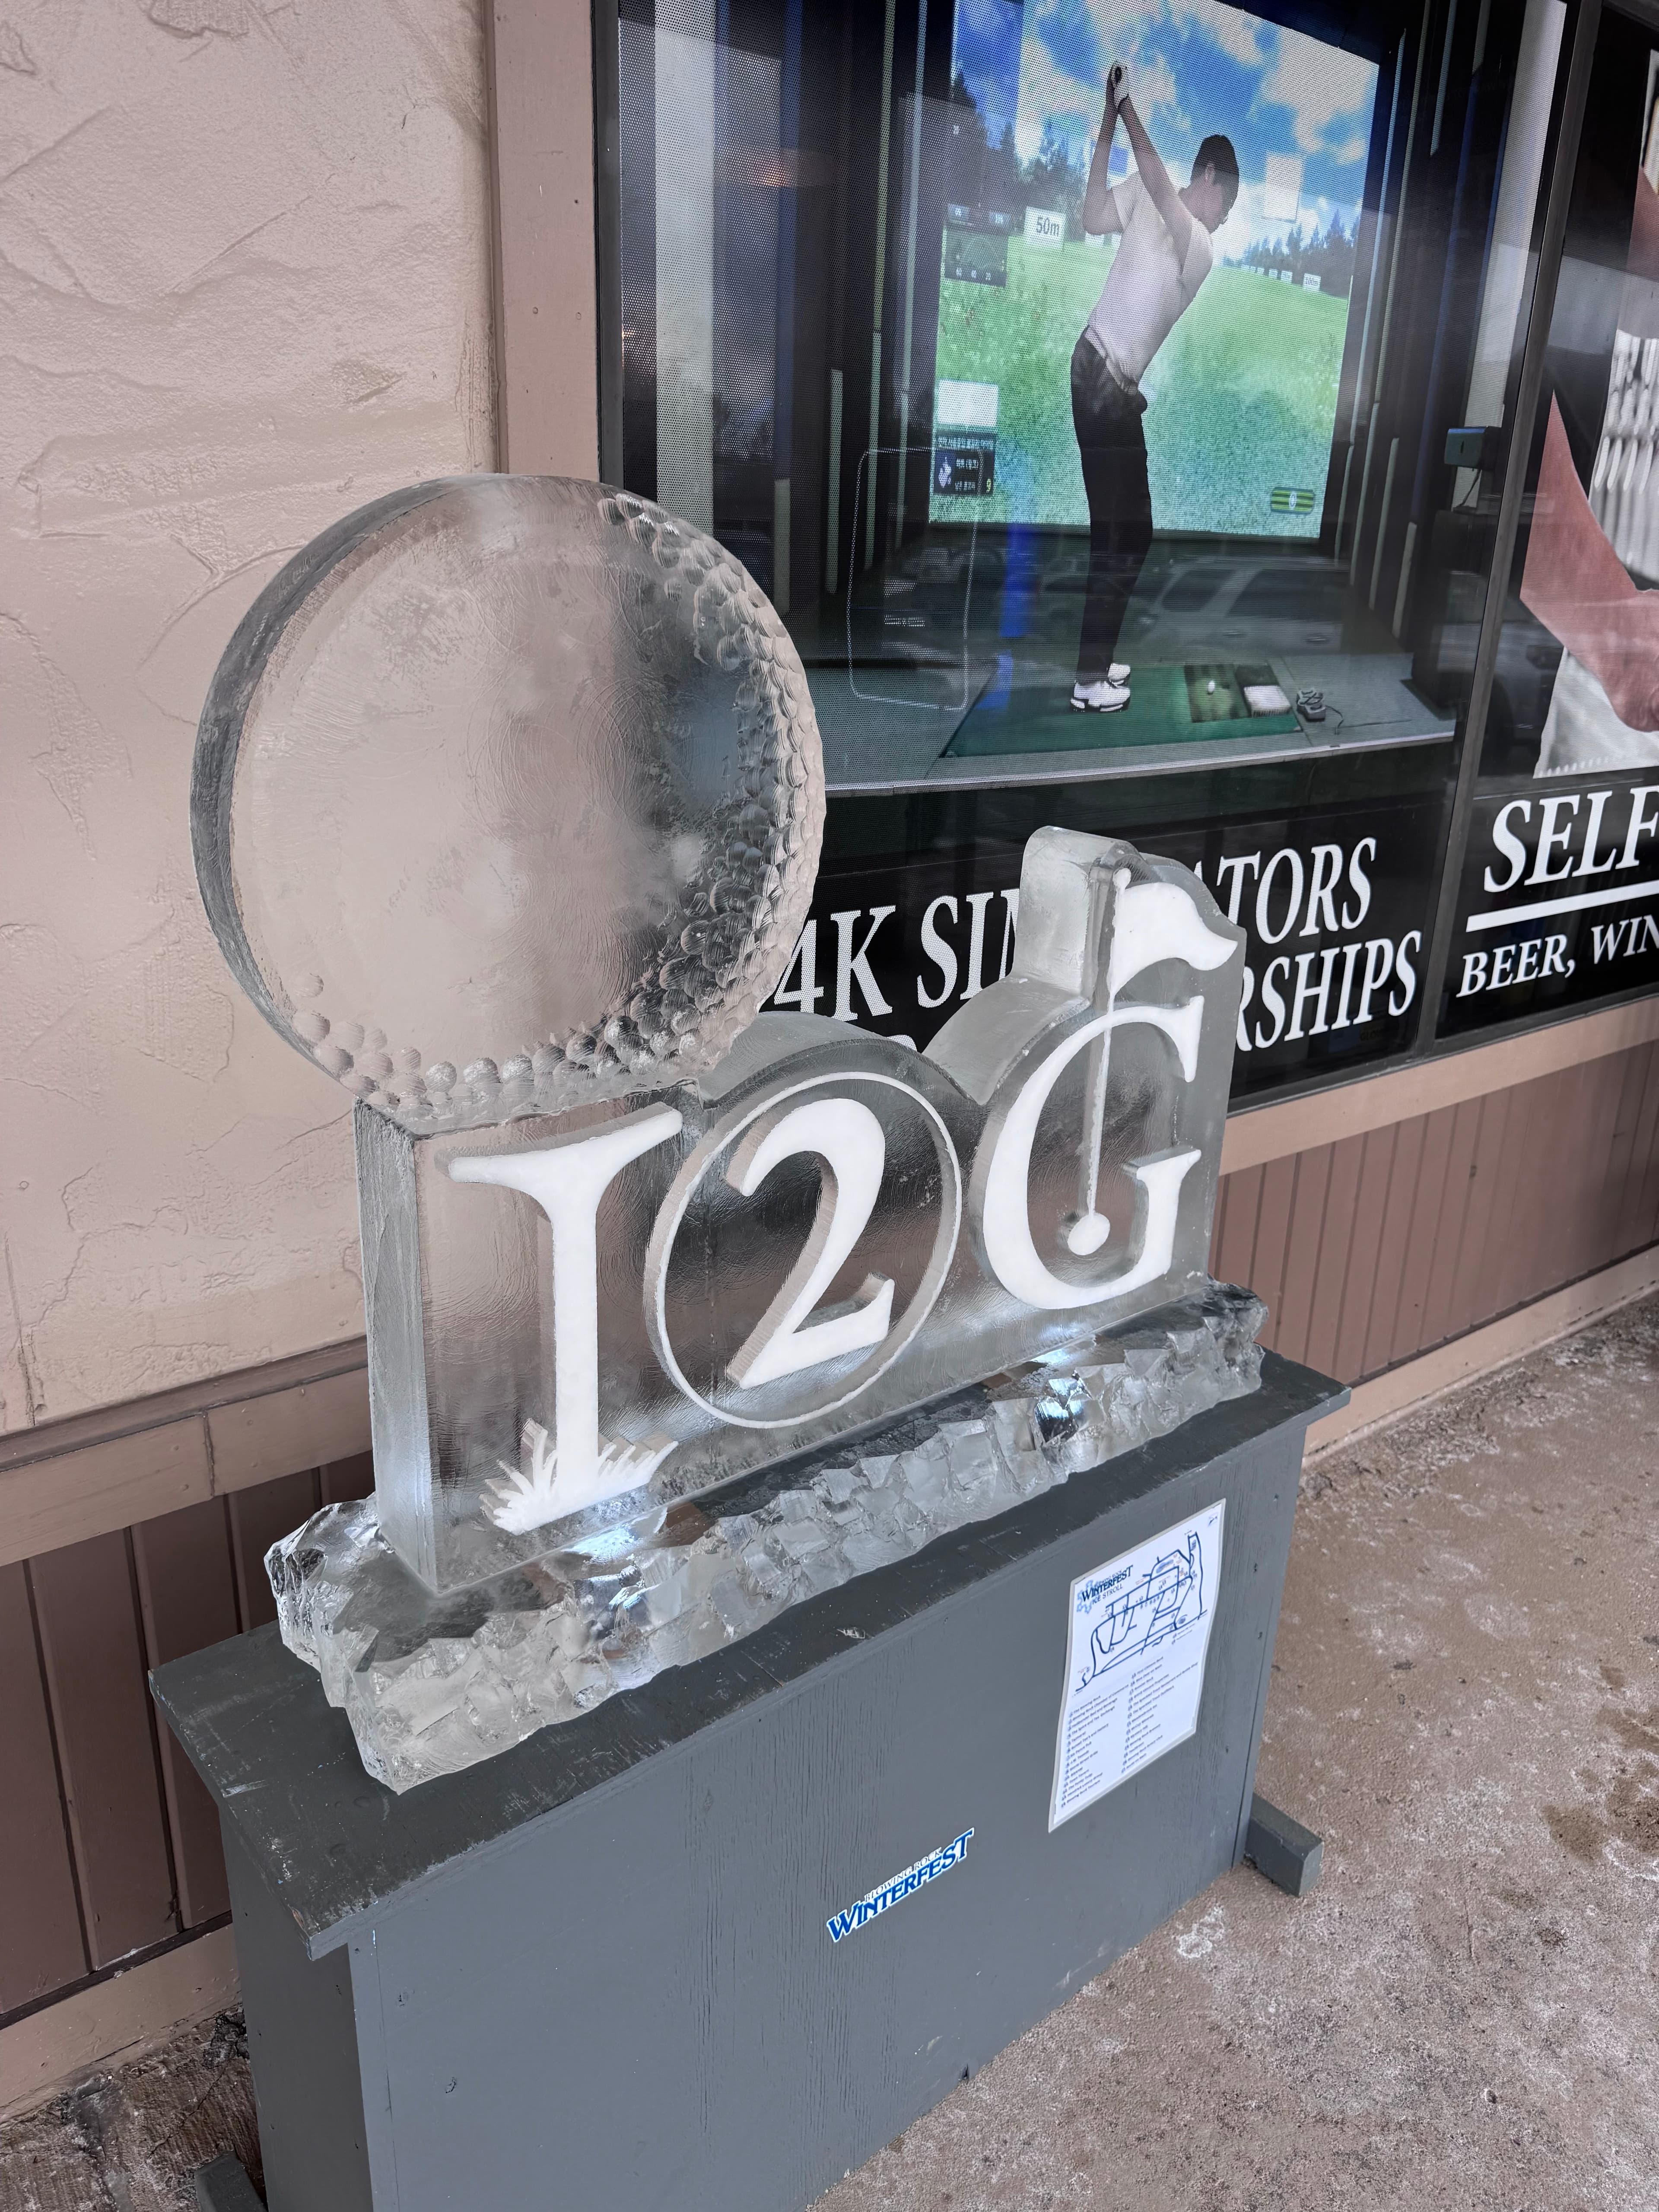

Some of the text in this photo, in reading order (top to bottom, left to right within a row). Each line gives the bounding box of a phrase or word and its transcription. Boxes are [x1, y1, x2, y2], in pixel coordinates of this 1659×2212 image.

[1036, 216, 1060, 236] 50m
[1484, 786, 1659, 893] SELF
[773, 905, 896, 1022] 4K
[1456, 934, 1576, 998] BEER,
[1082, 1564, 1133, 1602] WINTERFEST
[1092, 1584, 1123, 1605] ICE STROLL
[827, 1829, 973, 1942] WINTERFEST
[864, 1848, 942, 1902] BLOWING ROCK
